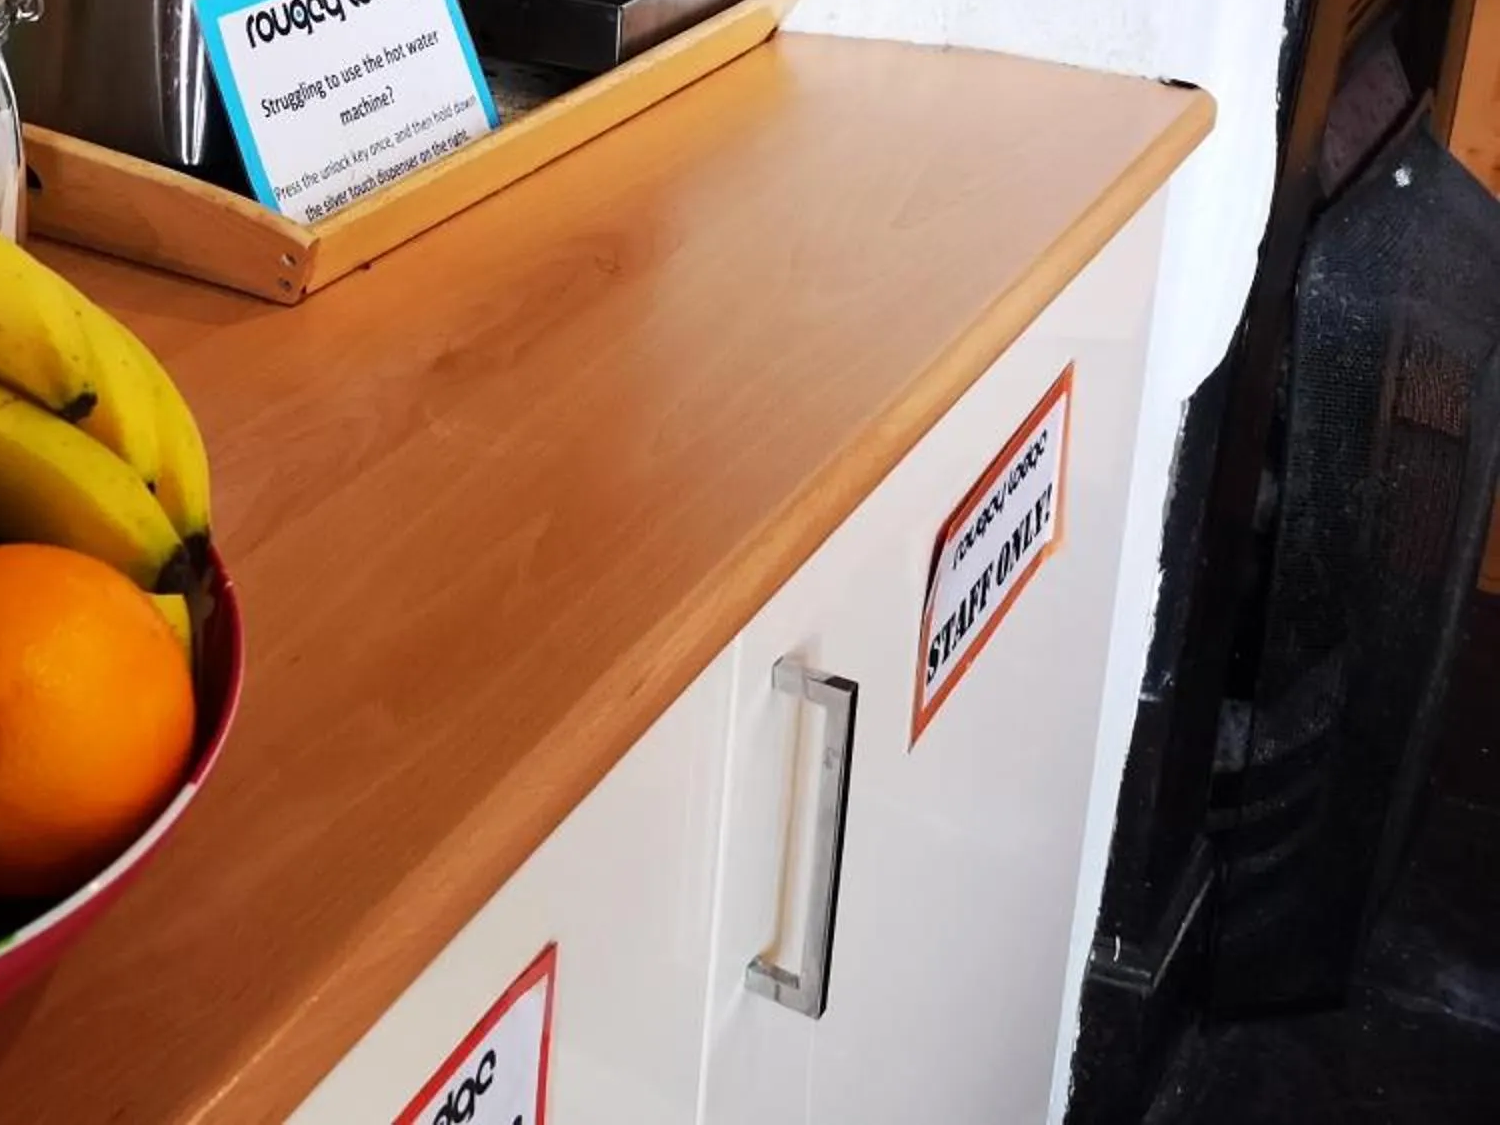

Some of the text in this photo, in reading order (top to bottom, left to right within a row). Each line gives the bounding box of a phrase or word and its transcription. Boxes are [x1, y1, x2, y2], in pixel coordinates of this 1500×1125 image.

[261, 31, 440, 118] Struggling to use the hot water
[340, 85, 396, 125] machine?
[274, 181, 303, 202] Press
[301, 171, 320, 189] the
[320, 155, 351, 181] unlock
[351, 148, 370, 165] key
[394, 123, 412, 143] and
[411, 115, 434, 133] then
[433, 102, 453, 121] hold
[453, 94, 477, 114] down
[305, 203, 324, 223] the
[323, 189, 348, 213] silver
[348, 175, 378, 203] touch
[419, 146, 434, 164] on
[433, 138, 449, 156] the
[926, 481, 1053, 686] STAFF ONLY!
